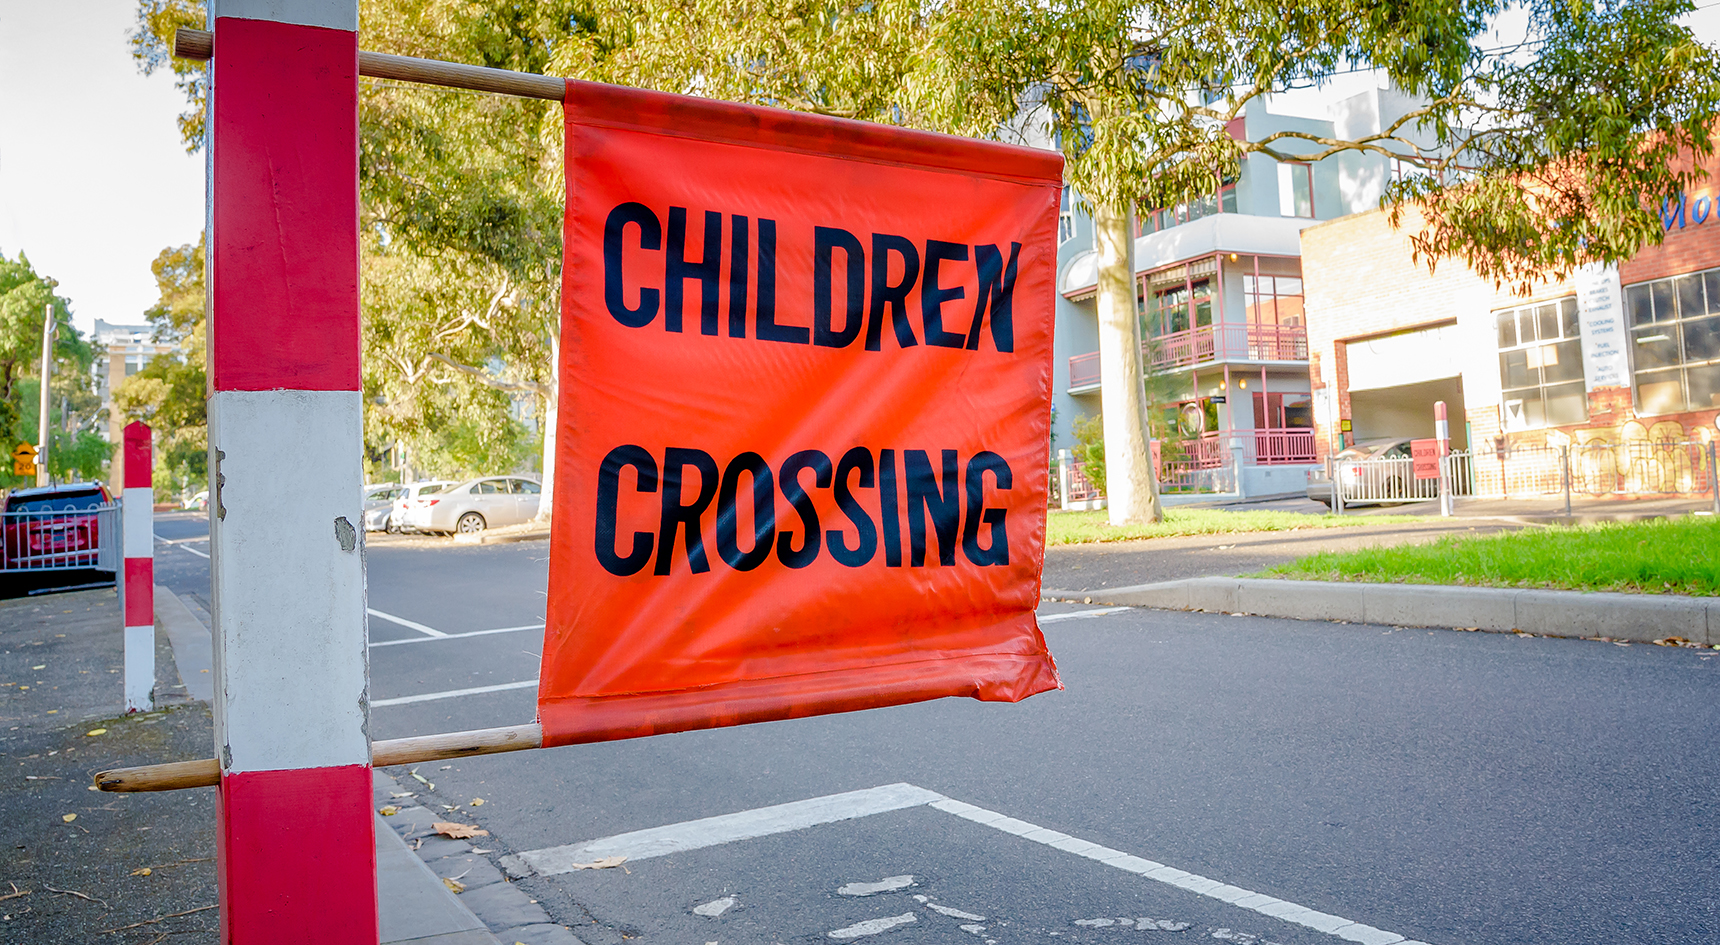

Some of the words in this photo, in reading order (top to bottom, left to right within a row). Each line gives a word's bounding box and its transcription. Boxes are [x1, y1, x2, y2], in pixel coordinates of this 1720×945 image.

[603, 201, 1022, 353] CHILDREN
[1589, 318, 1615, 327] COOLING
[1592, 327, 1614, 335] SYSTEMS
[1591, 350, 1619, 358] INJECTION
[1414, 449, 1435, 457] CHILDREN
[18, 463, 32, 471] 20
[594, 444, 1013, 577] CROSSING
